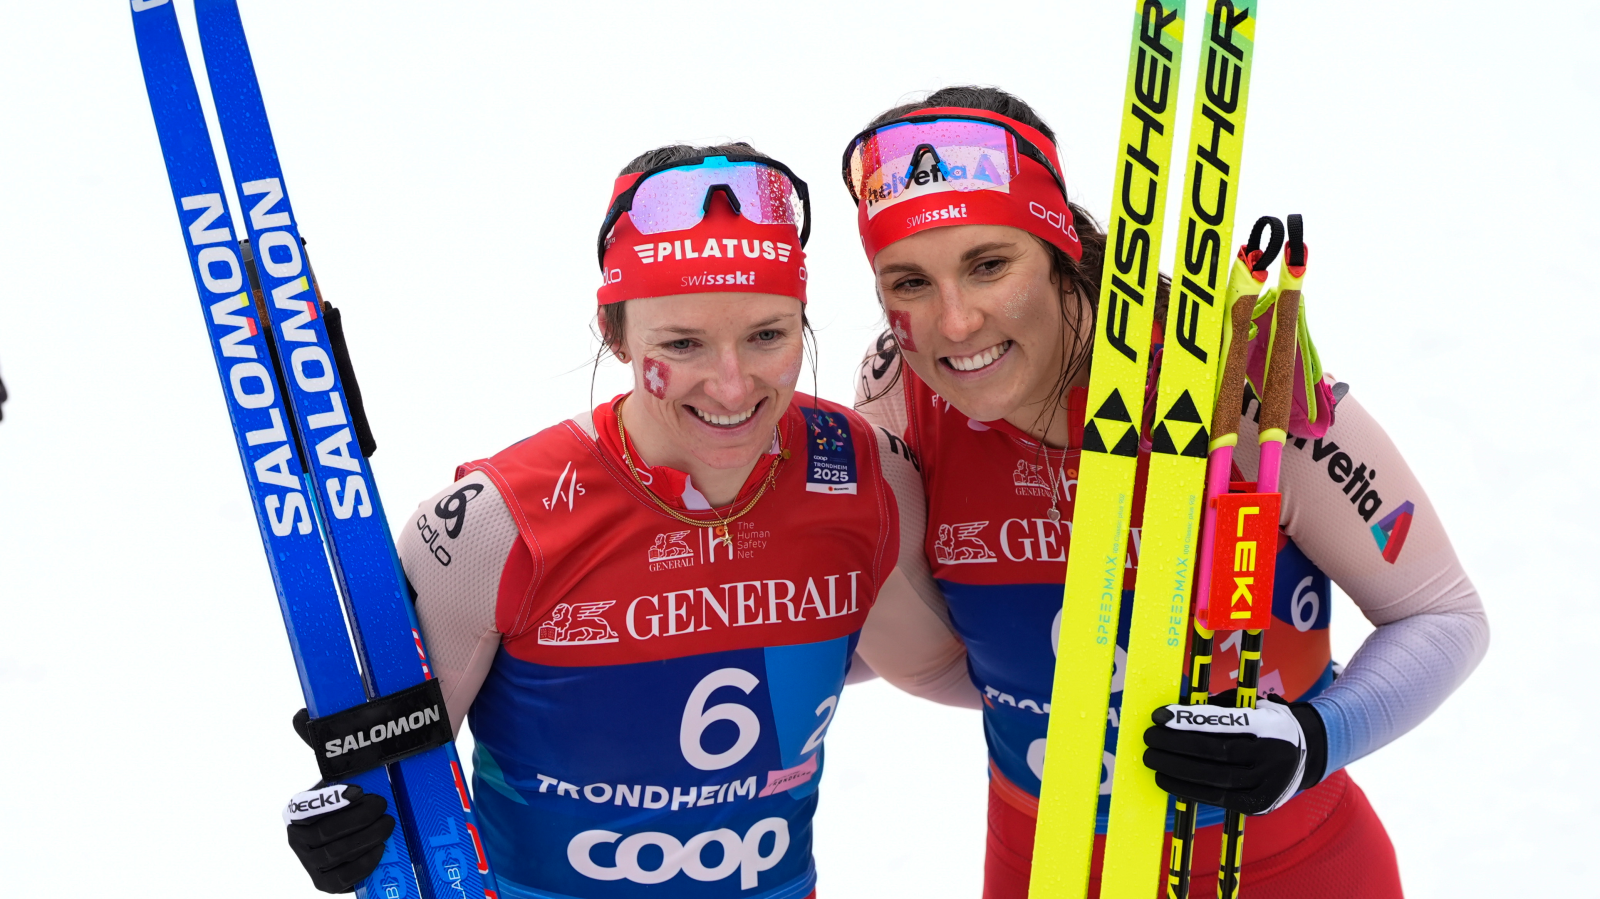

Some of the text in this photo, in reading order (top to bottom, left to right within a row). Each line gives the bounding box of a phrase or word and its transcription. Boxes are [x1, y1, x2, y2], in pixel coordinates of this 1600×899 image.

[1106, 0, 1177, 363] FISCHER
[1176, 0, 1249, 364] FISCHER
[906, 203, 967, 229] swissski
[1029, 201, 1079, 242] odlo
[657, 238, 778, 263] PILATUS
[680, 270, 756, 288] swissski
[181, 192, 313, 537] SALOMON
[241, 177, 373, 520] SALOMON
[813, 461, 848, 471] TRONDHEIM
[813, 467, 849, 482] 2025
[416, 513, 453, 567] odlo
[737, 521, 755, 530] The
[737, 529, 771, 540] Human
[737, 539, 768, 551] Safety
[648, 557, 695, 573] GENERALI
[737, 550, 755, 560] Net
[1230, 506, 1260, 620] LEKI
[625, 570, 862, 641] GENERALI
[1096, 555, 1118, 646] SPEEDMAX
[1167, 557, 1189, 647] SPEEDMAX
[1185, 521, 1193, 544] Classic
[1290, 575, 1320, 632] 6
[325, 704, 441, 759] SALOMON
[679, 667, 761, 771] 6
[800, 695, 838, 756] 2
[536, 772, 758, 811] TRONDHEIM
[566, 816, 790, 891] coop
